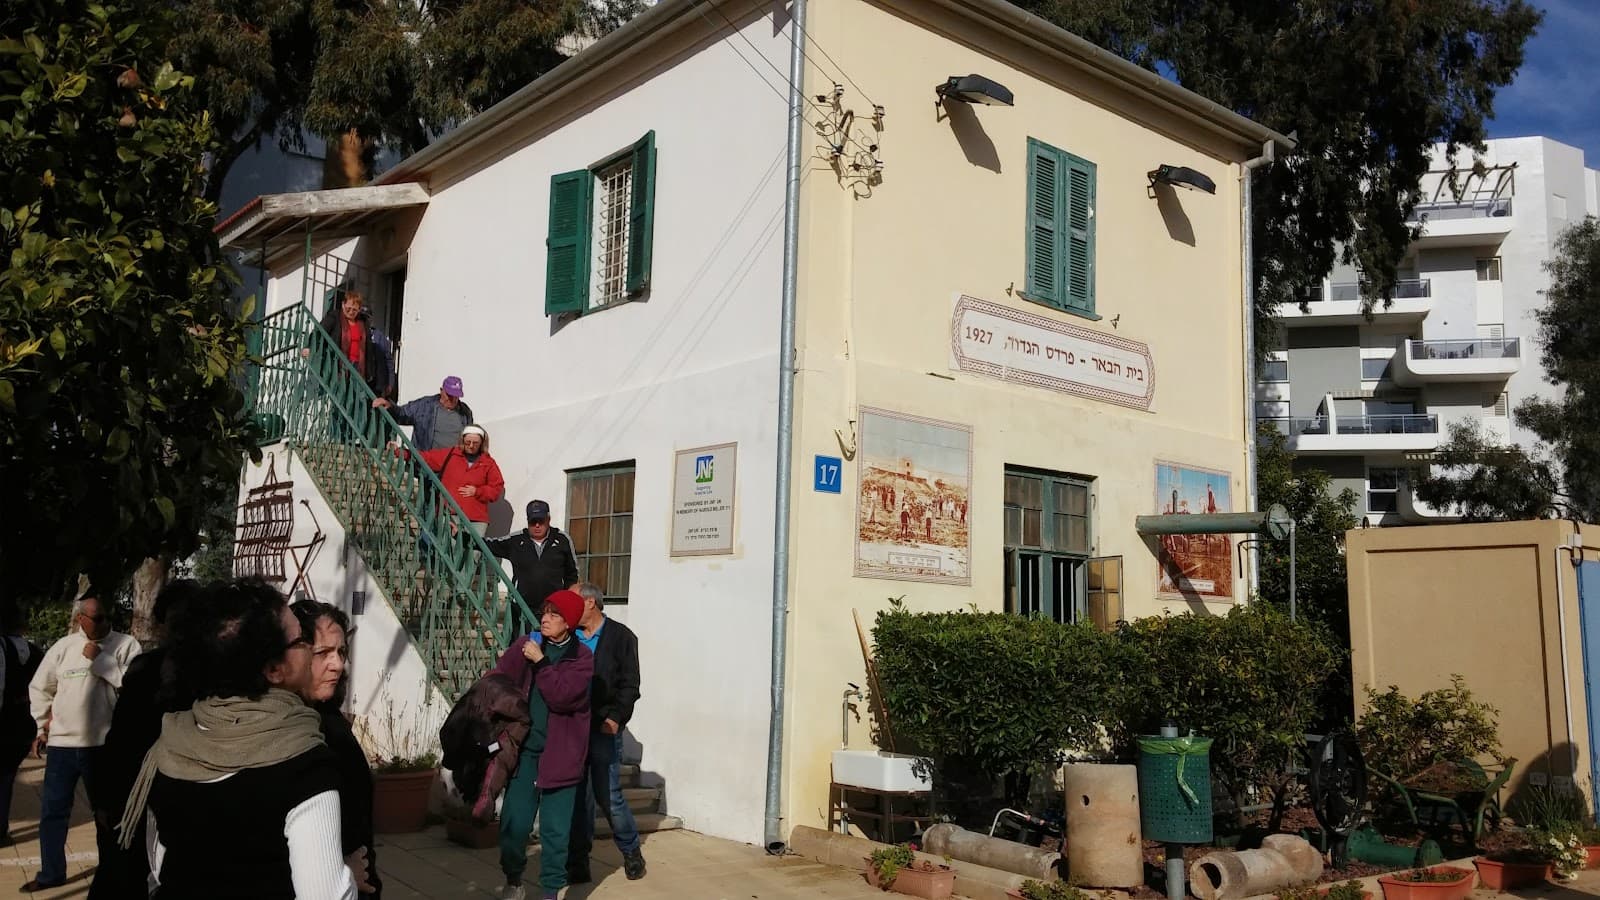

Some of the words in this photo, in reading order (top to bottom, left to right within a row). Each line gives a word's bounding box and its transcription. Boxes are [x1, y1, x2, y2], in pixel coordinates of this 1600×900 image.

[965, 325, 993, 345] 1927
[1045, 345, 1075, 365] פרדס
[1091, 356, 1121, 376] הבאר
[1126, 365, 1144, 382] בית
[820, 464, 838, 486] 17
